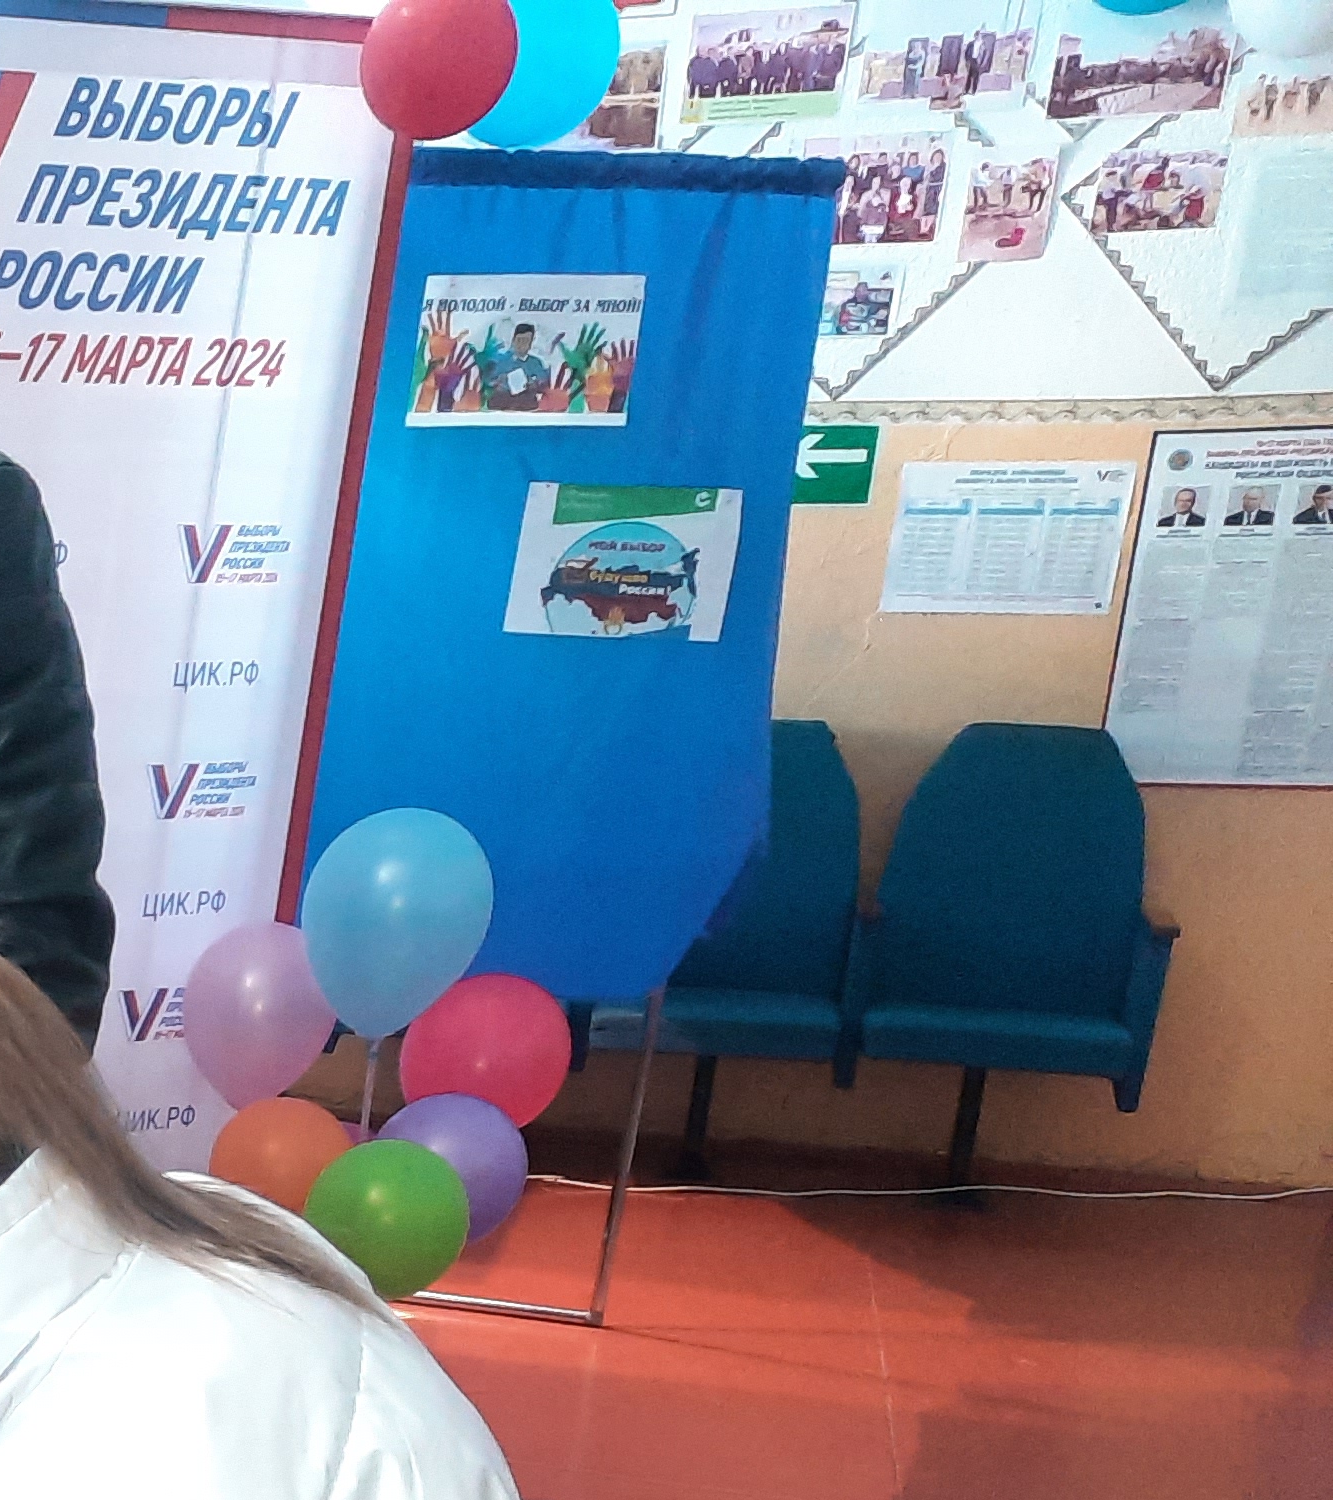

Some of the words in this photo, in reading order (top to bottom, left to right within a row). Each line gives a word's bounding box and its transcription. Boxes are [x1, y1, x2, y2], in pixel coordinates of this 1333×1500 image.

[53, 76, 301, 149] ВЫБОРЫ
[16, 163, 352, 241] ПРЕЗИДЕНТА
[571, 298, 591, 313] ЗА
[60, 333, 194, 386] МАРТА
[191, 337, 287, 388] 2024
[172, 659, 260, 694] ЦИК.РФ
[141, 889, 227, 922] ЦИК.РФ
